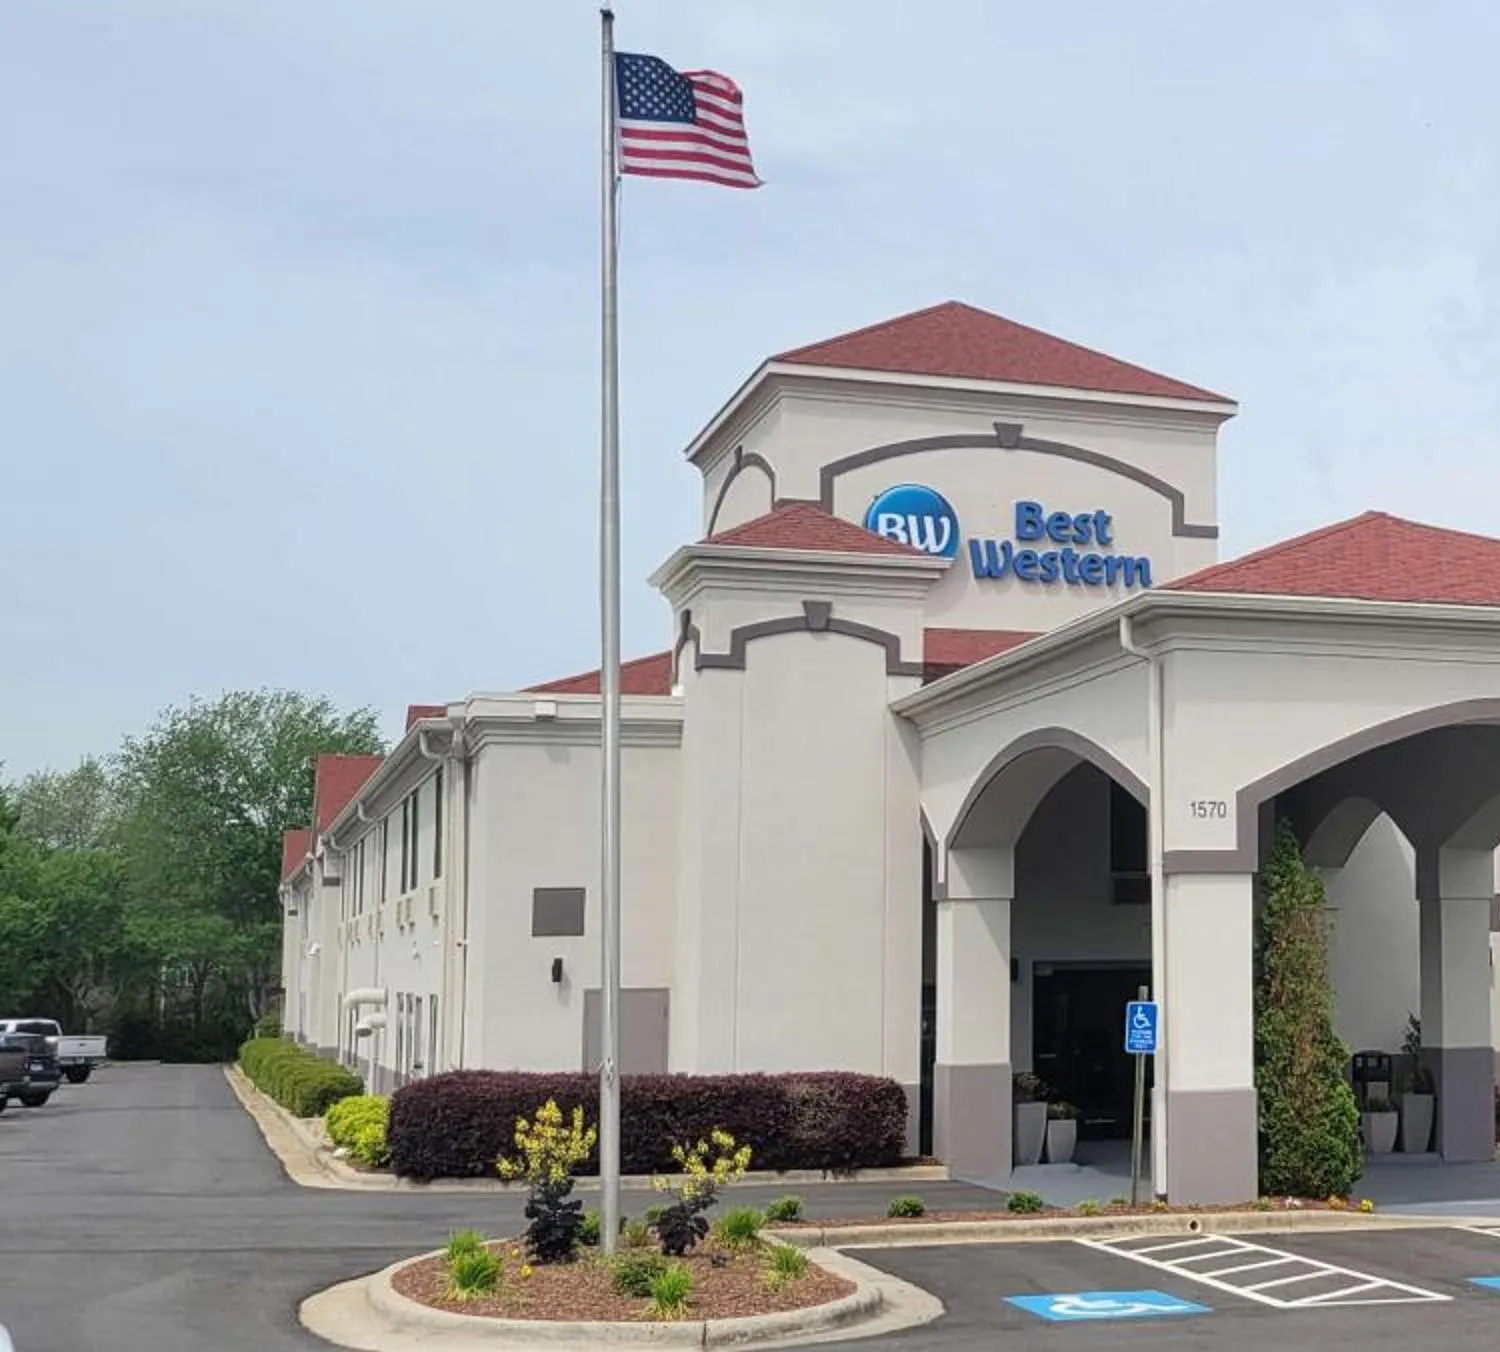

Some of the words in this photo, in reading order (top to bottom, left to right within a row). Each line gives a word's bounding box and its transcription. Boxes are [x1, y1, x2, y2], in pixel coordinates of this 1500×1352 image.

[877, 512, 951, 553] BW
[1014, 500, 1113, 546] Best
[968, 538, 1152, 587] Western
[1191, 801, 1227, 818] 1570
